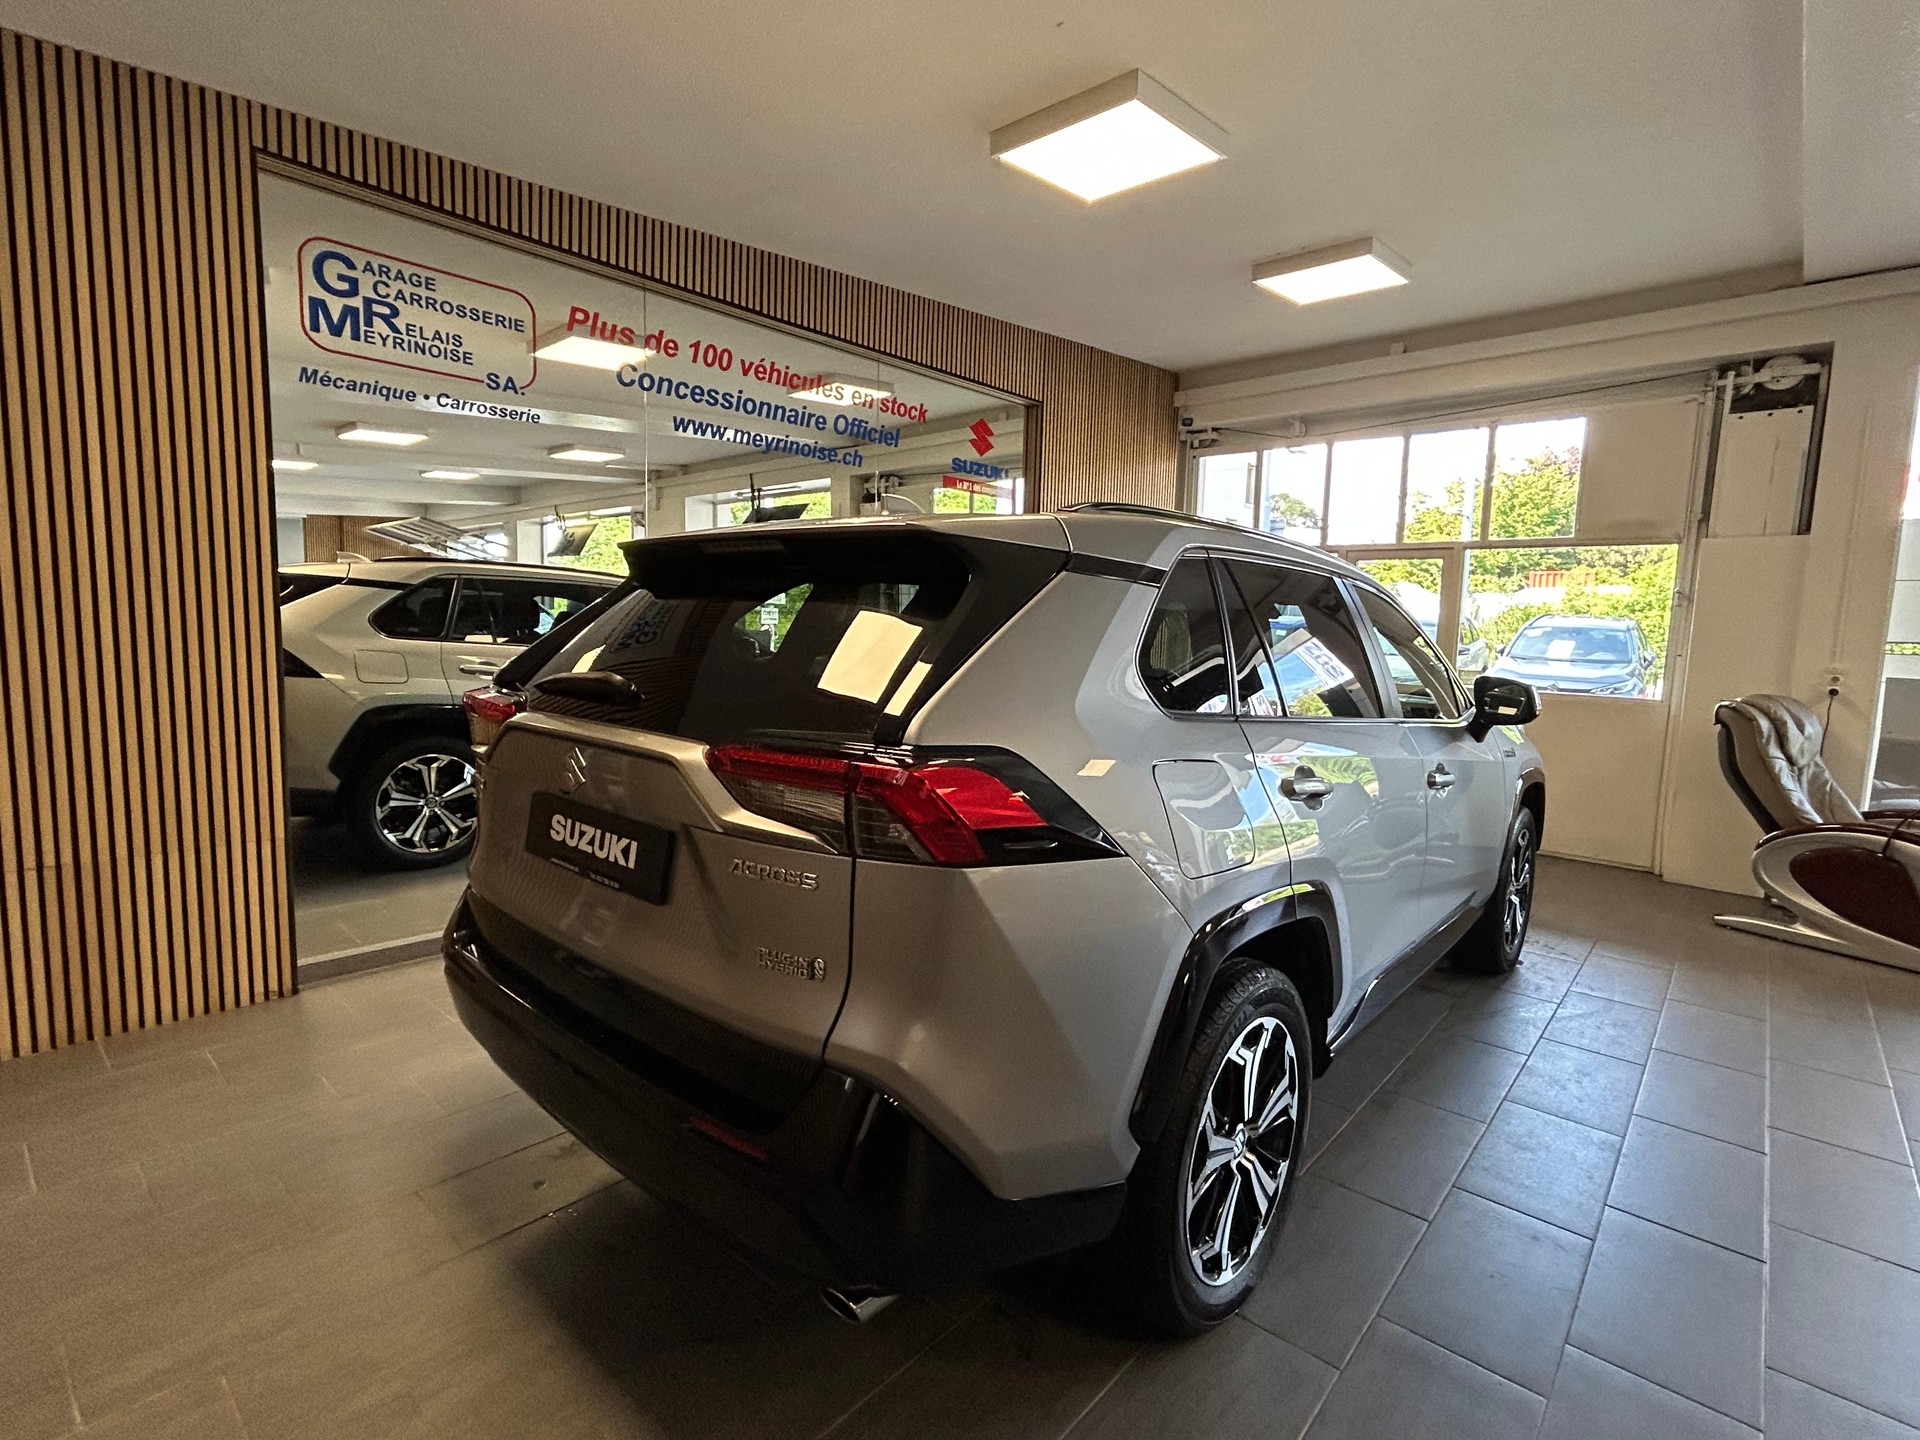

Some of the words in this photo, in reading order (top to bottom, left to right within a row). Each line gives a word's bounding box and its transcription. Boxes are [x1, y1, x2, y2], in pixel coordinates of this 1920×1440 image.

[312, 250, 437, 298] GARAGE
[308, 296, 474, 366] MEYRINOISE
[362, 296, 463, 348] RELAIS
[372, 280, 525, 333] CARROSSERIE
[486, 372, 526, 396] SA.
[566, 305, 635, 345] Plus
[644, 329, 679, 358] de
[688, 340, 733, 372] 100
[740, 358, 844, 401] véhicules
[851, 390, 874, 410] en
[879, 397, 928, 423] stock
[298, 366, 417, 402] Mécanique
[436, 392, 541, 424] Carrosserie
[616, 362, 827, 431] Concessionnaire
[833, 414, 900, 448] Officiel
[672, 416, 863, 467] www.meyrinoise.ch
[951, 457, 1009, 479] SUZUKI
[549, 814, 638, 869] SUZUKI
[731, 859, 819, 890] ACROSS
